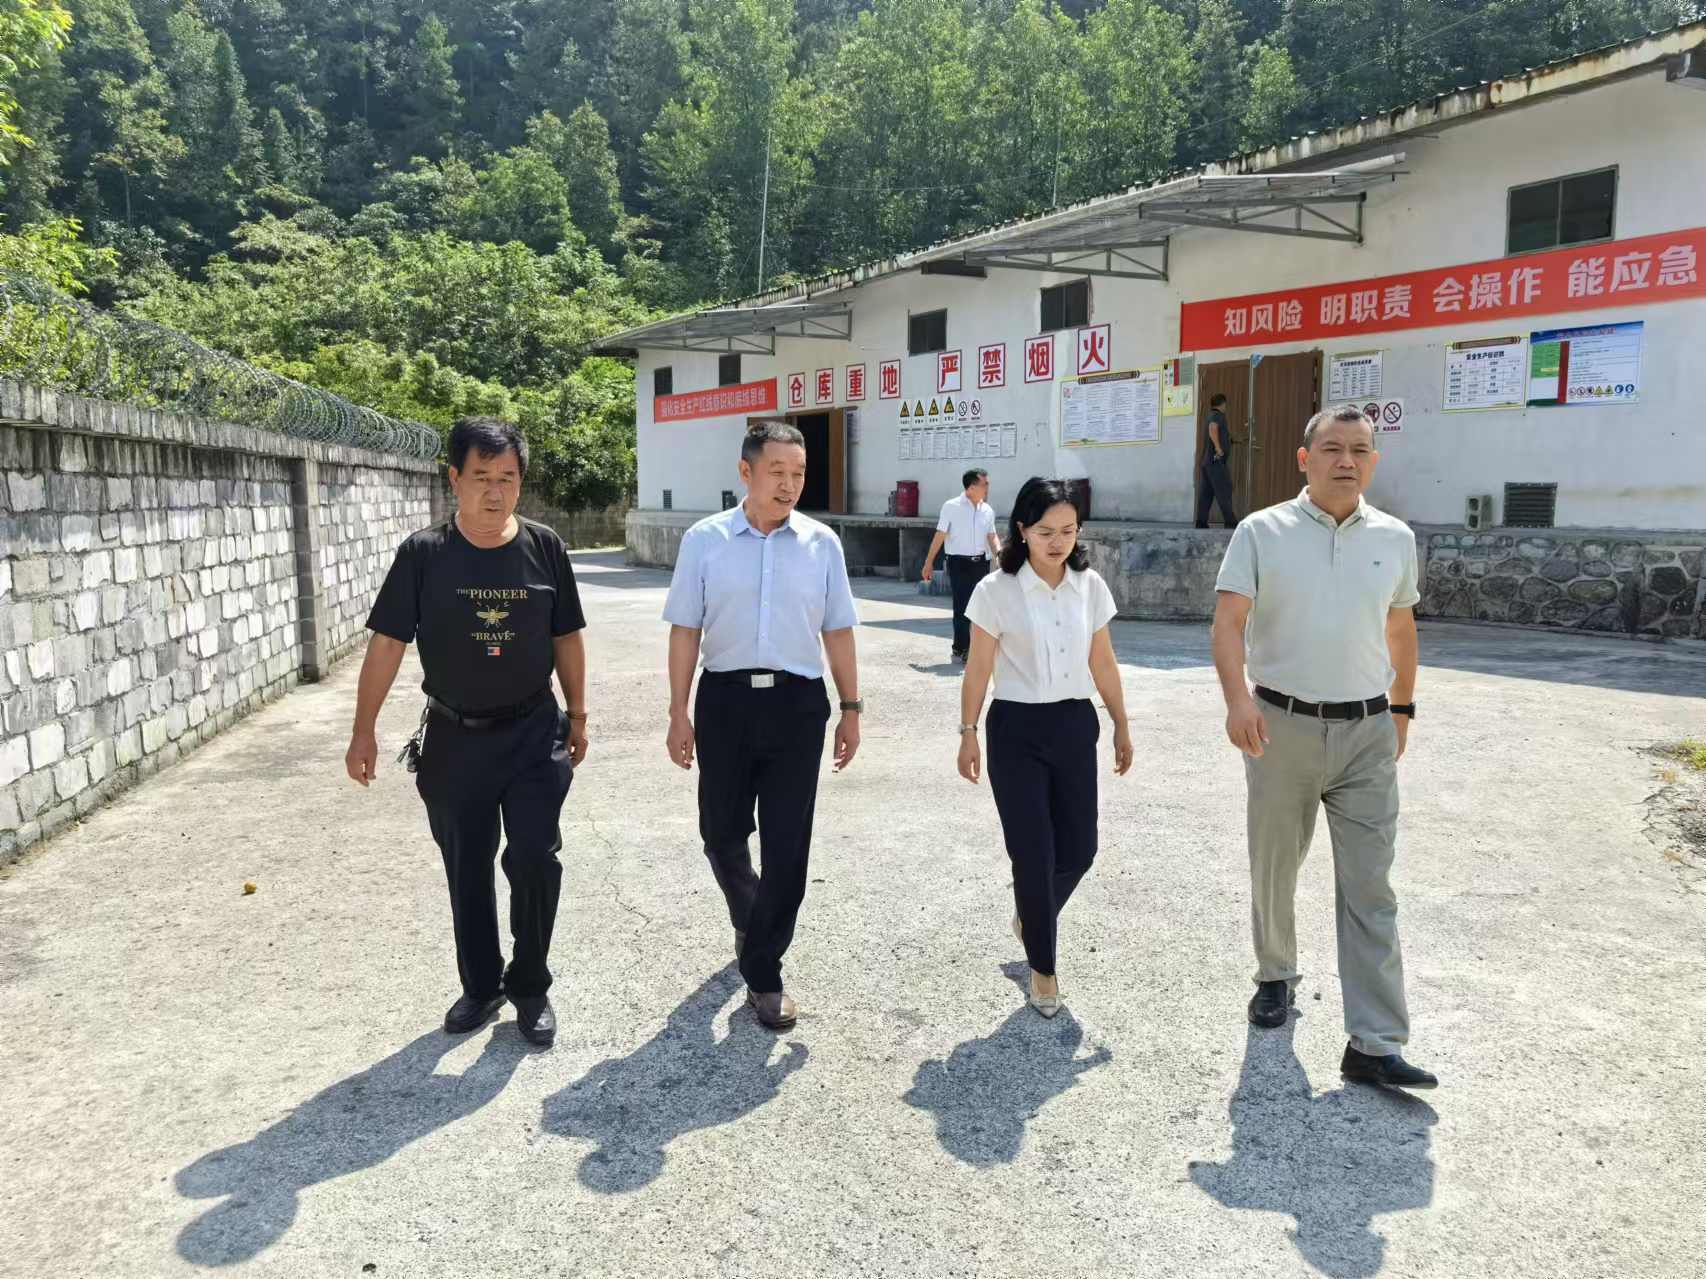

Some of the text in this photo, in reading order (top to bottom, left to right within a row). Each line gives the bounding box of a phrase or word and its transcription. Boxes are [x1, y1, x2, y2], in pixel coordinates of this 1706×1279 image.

[1224, 244, 1697, 337] 知风险 明职责 会操作 能应急
[790, 331, 1105, 404] 仓库重地 严禁烟火
[470, 589, 528, 599] PIONEER
